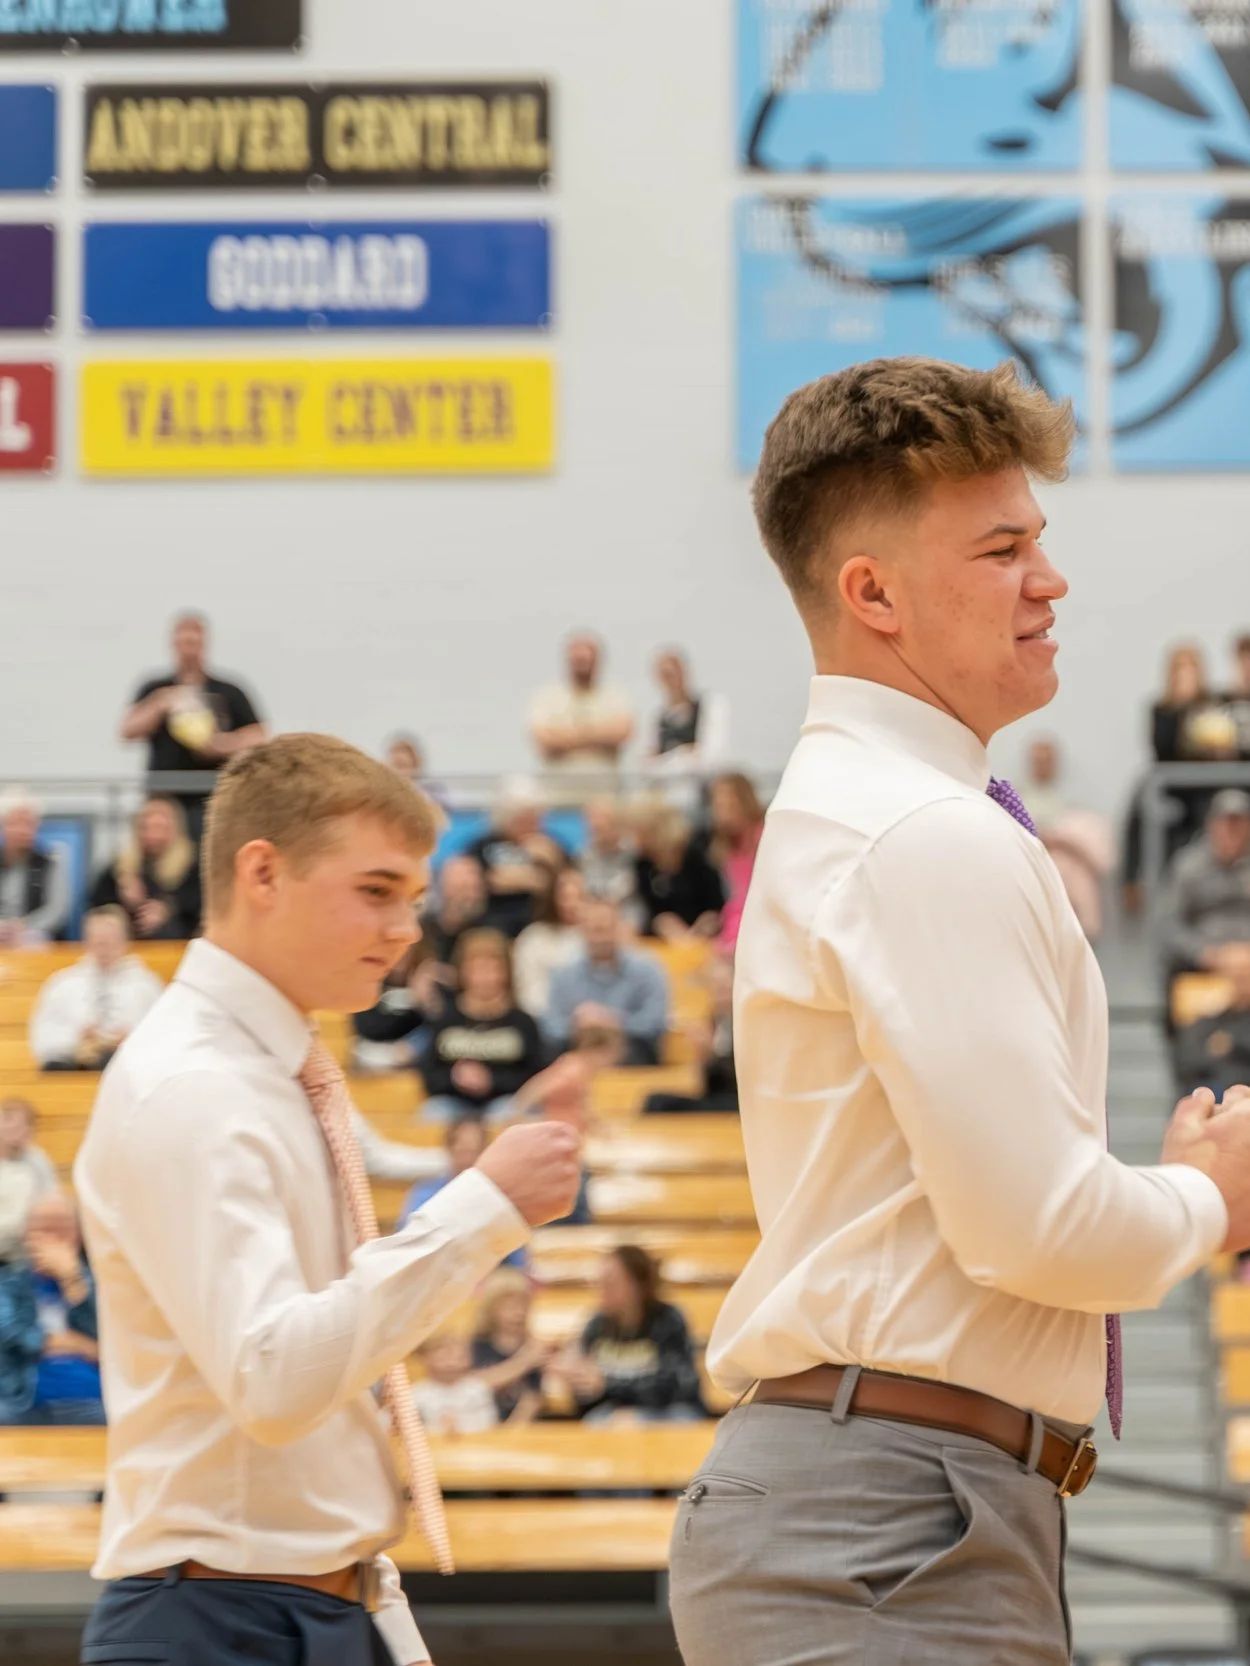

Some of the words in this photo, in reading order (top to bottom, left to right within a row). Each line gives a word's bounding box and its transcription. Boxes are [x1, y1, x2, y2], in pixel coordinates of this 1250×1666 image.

[88, 98, 310, 172] ANDOVER
[323, 96, 550, 172] CENTRAL
[208, 235, 429, 311] GODDARD
[119, 381, 304, 447] VALLEY
[327, 380, 515, 446] CENTER
